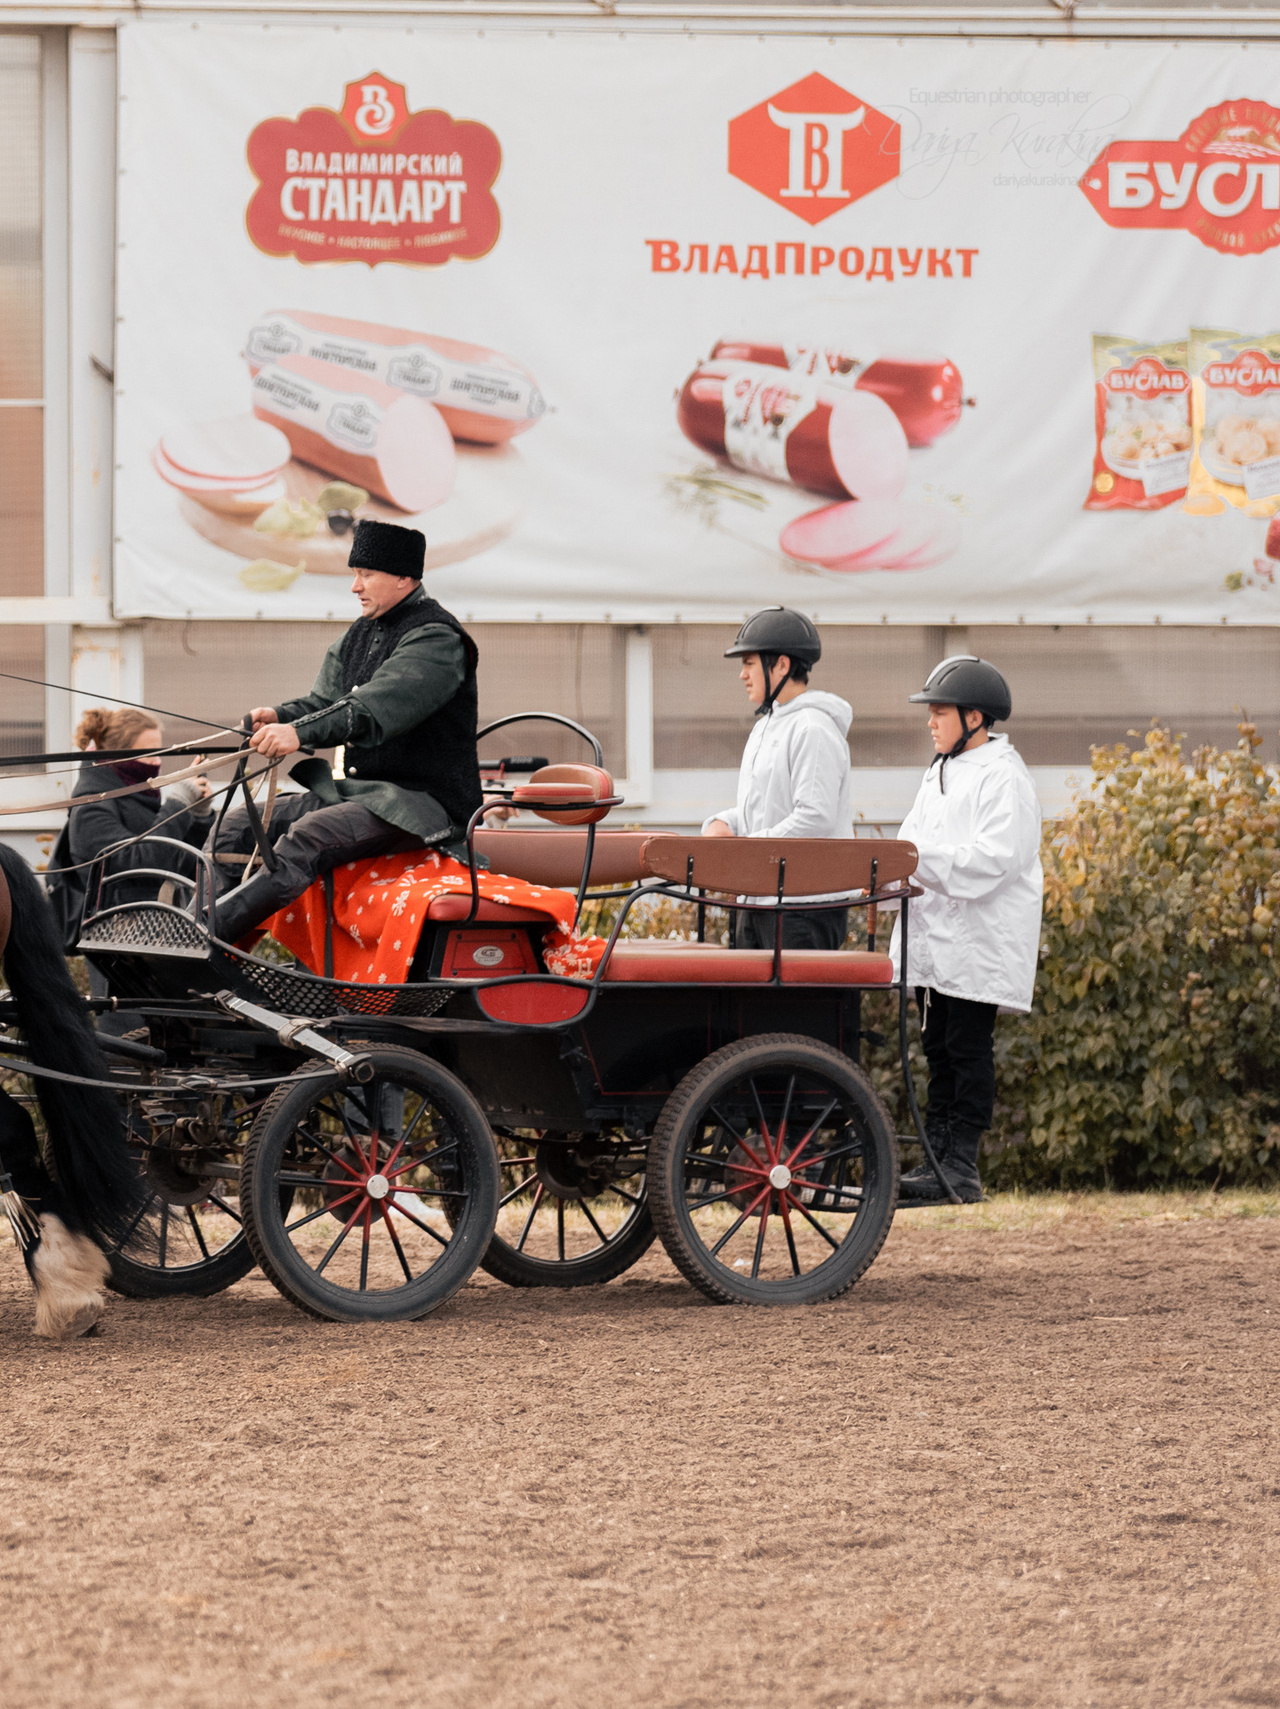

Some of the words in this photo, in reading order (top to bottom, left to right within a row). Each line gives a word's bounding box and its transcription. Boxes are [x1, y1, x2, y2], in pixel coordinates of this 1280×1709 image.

[280, 176, 467, 226] СТАНДАРТ
[1110, 373, 1185, 391] БУСЛАВ
[1208, 367, 1280, 386] БУСЛА
